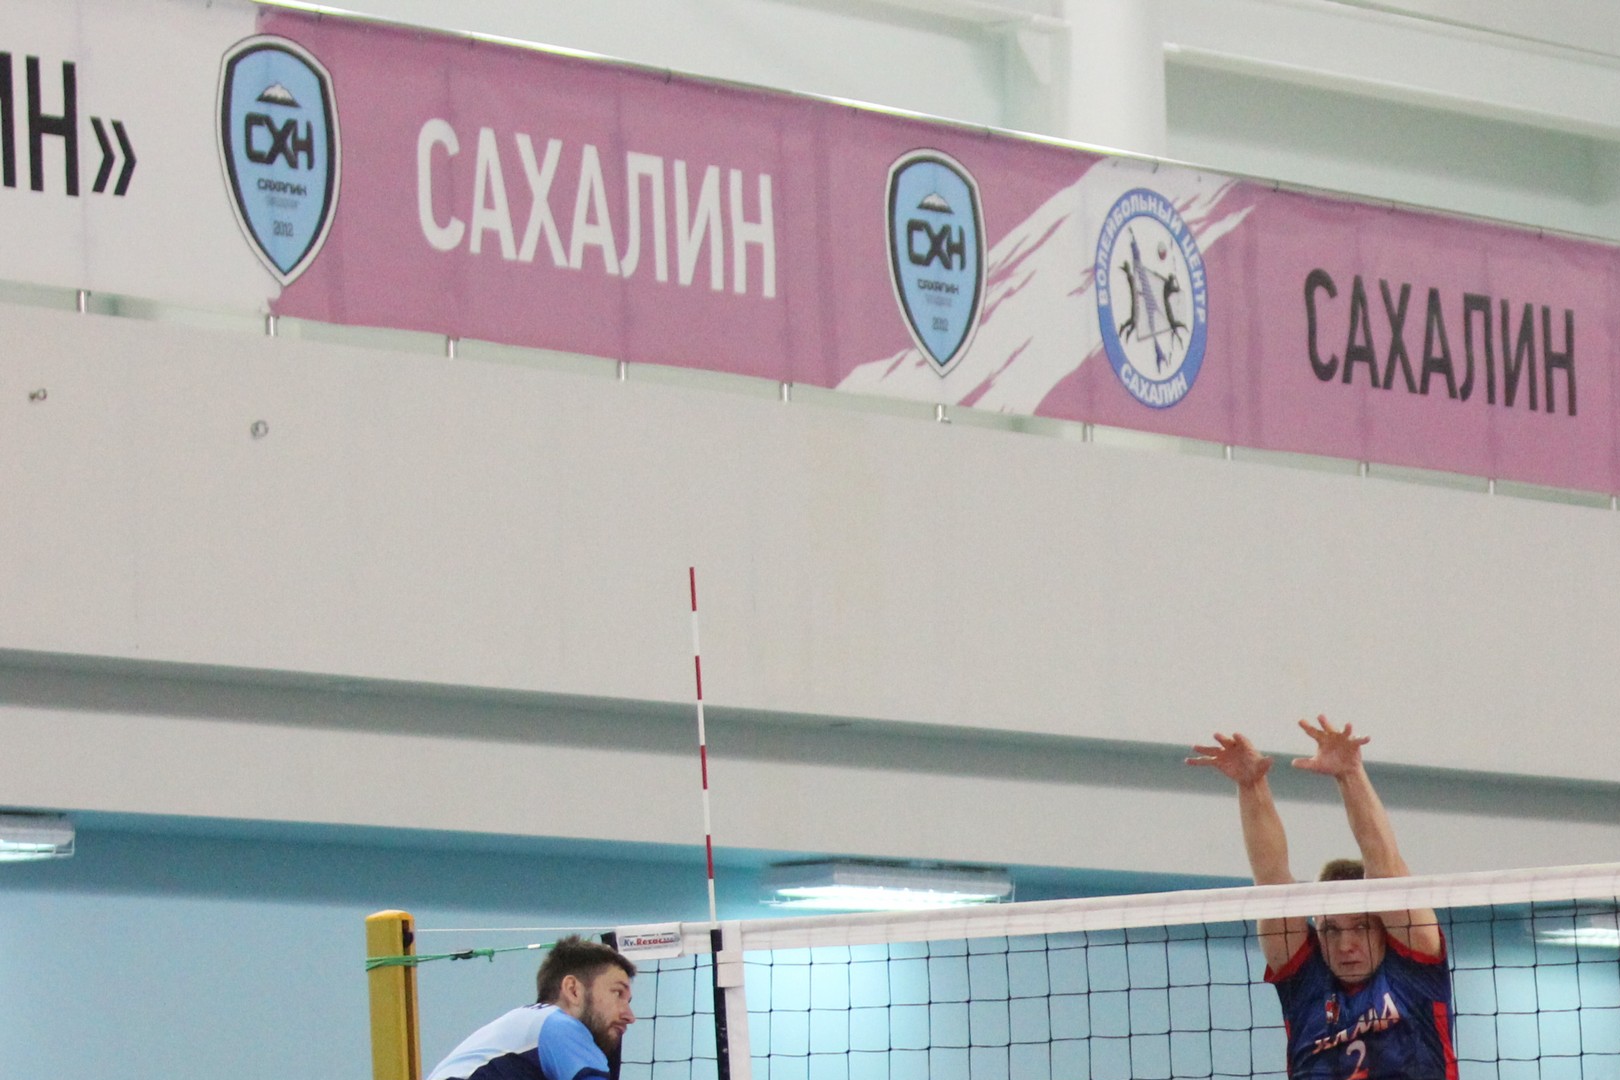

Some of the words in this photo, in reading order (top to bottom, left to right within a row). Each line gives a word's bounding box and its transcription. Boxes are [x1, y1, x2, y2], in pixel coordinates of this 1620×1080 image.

[416, 118, 777, 298] САХАЛИН
[1096, 193, 1182, 306] ВОЛЕЙБОЛЬНЫЙ
[1181, 234, 1207, 323] ЦЕНТР
[1120, 362, 1188, 406] САХАЛИН
[1303, 268, 1578, 417] САХАЛИН
